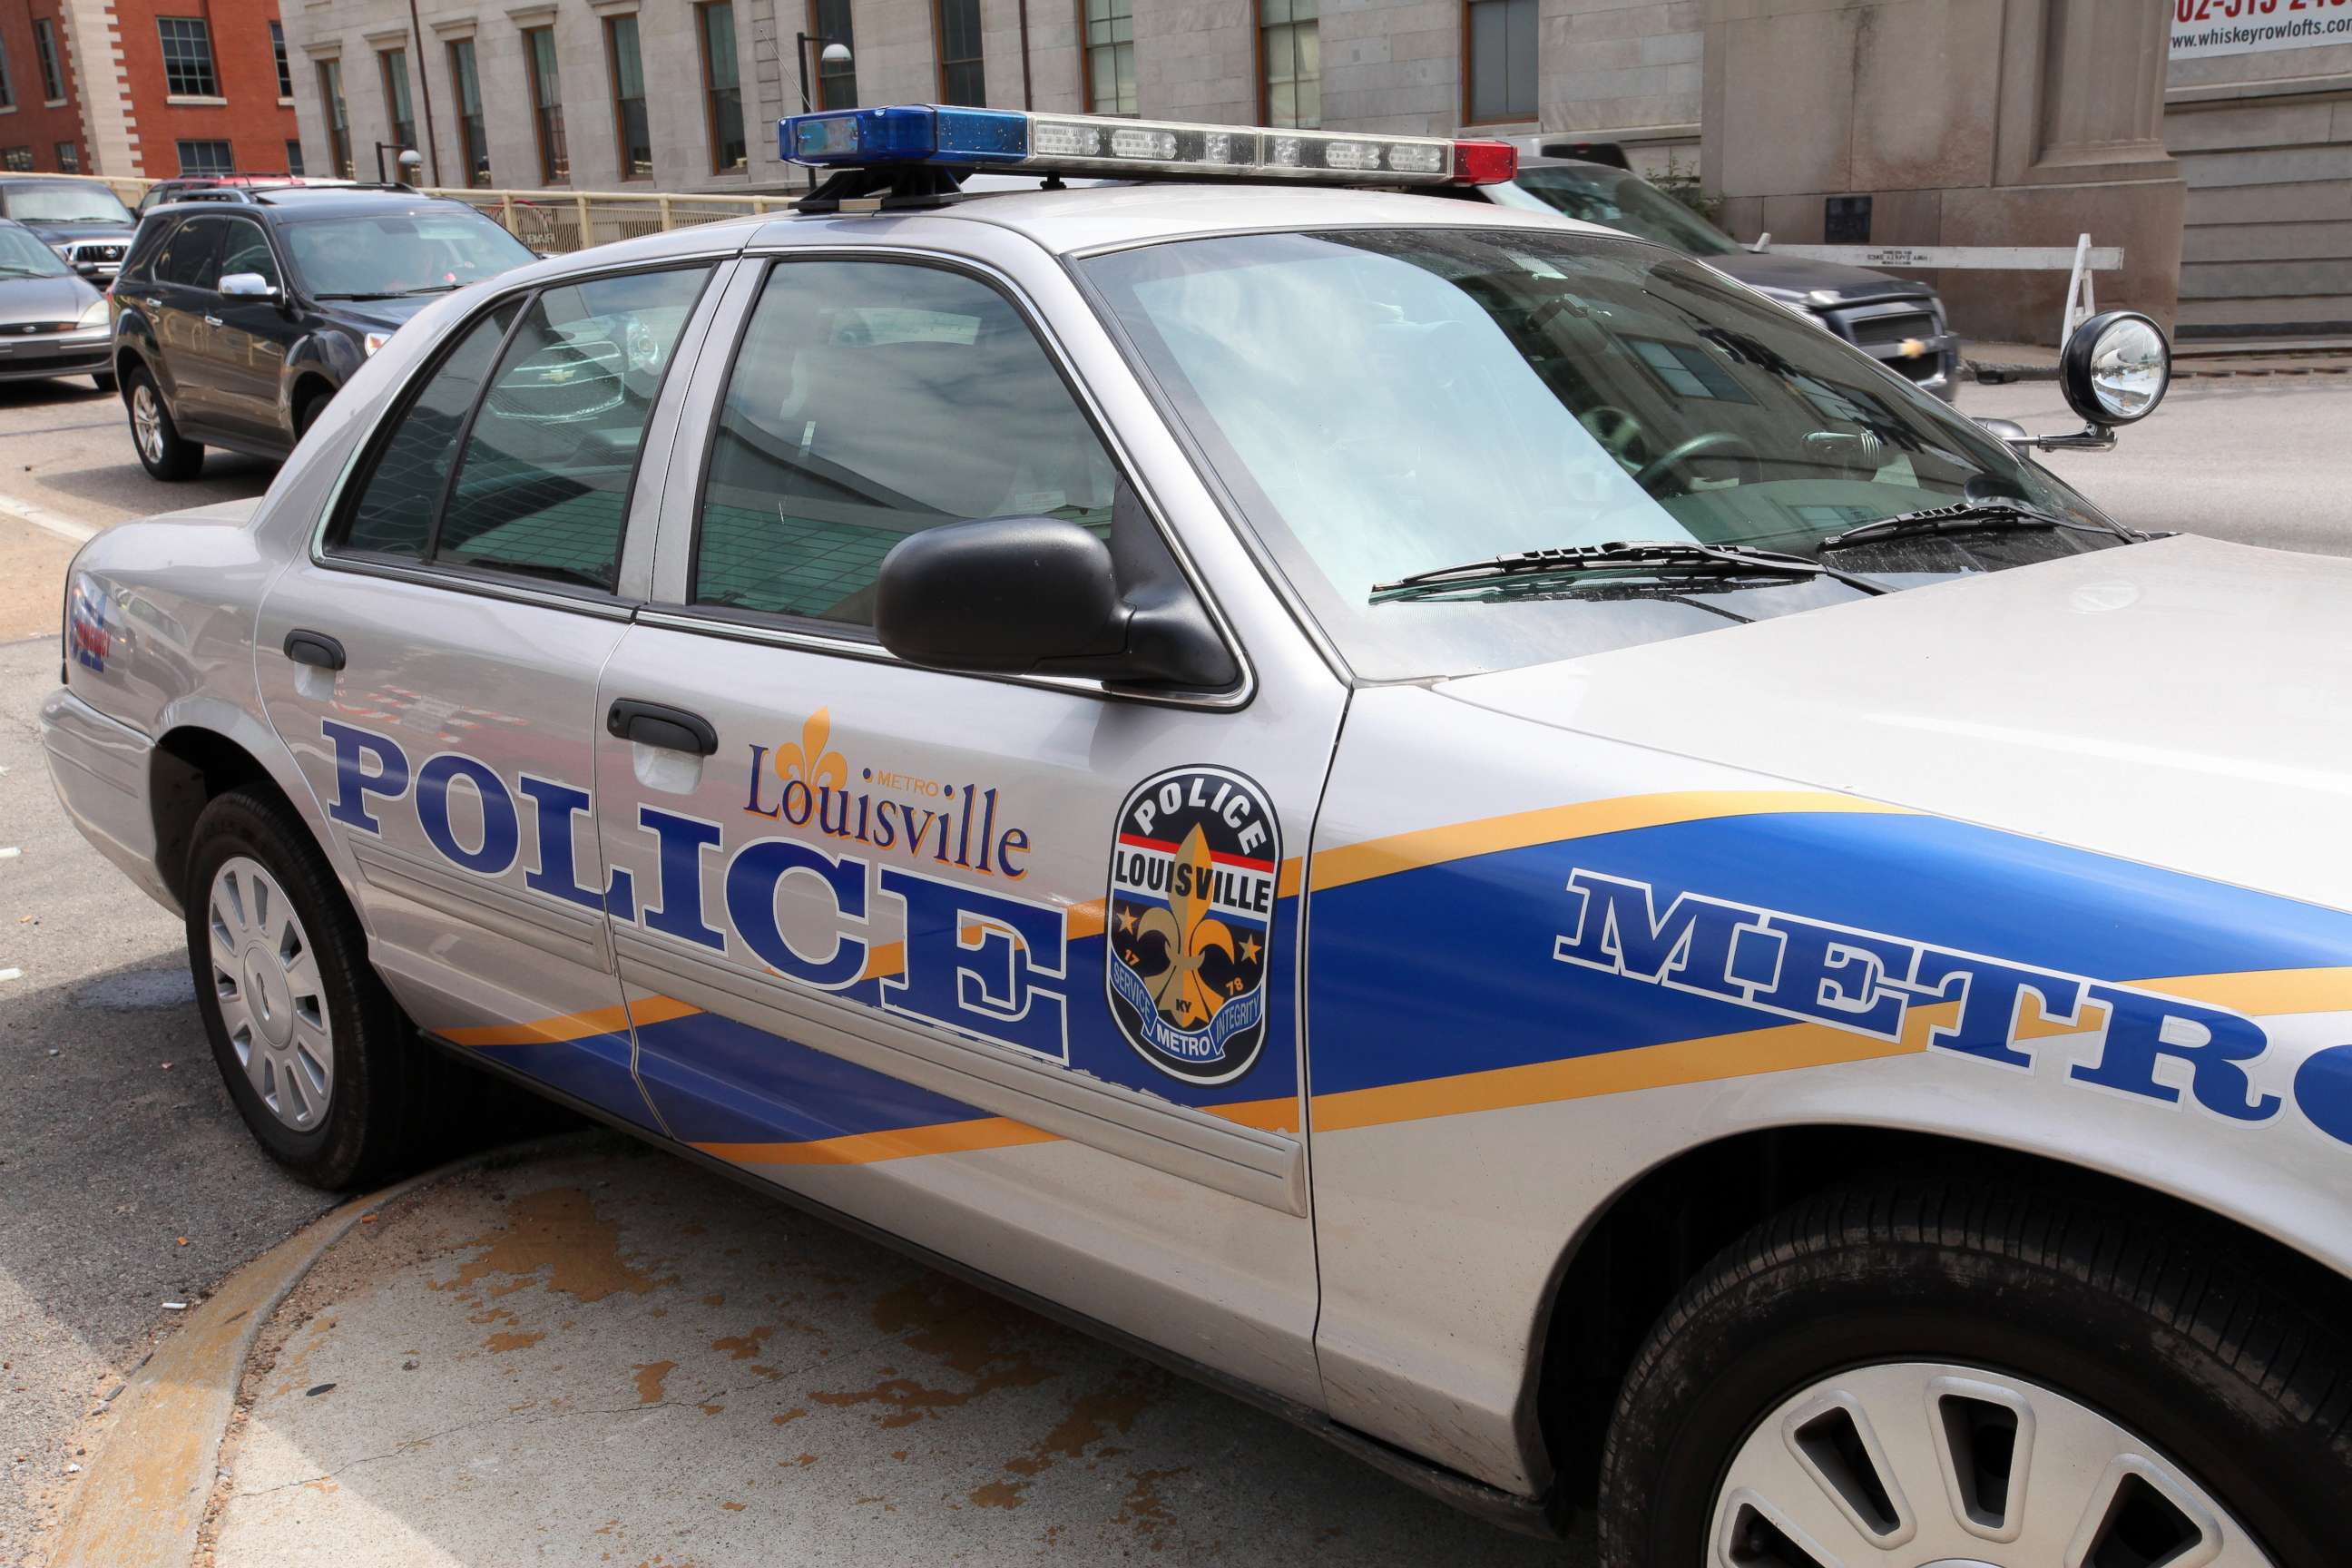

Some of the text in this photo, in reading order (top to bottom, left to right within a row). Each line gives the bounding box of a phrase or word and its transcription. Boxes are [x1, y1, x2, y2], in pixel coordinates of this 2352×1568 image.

[2171, 18, 2352, 49] ww.whiskeyrowlofts.co
[877, 770, 939, 797] METRO
[743, 744, 1032, 882] Louisville
[1133, 777, 1268, 856] POLICE
[320, 716, 1070, 1068] POLICE
[1114, 850, 1271, 914] LOUISVILLE
[1124, 949, 1141, 966] 17
[1113, 962, 1151, 1024] SERVICE
[1175, 998, 1191, 1014] KY
[1225, 976, 1244, 996] 78
[1156, 1023, 1210, 1056] METRO
[1216, 994, 1259, 1044] INTEGRITY
